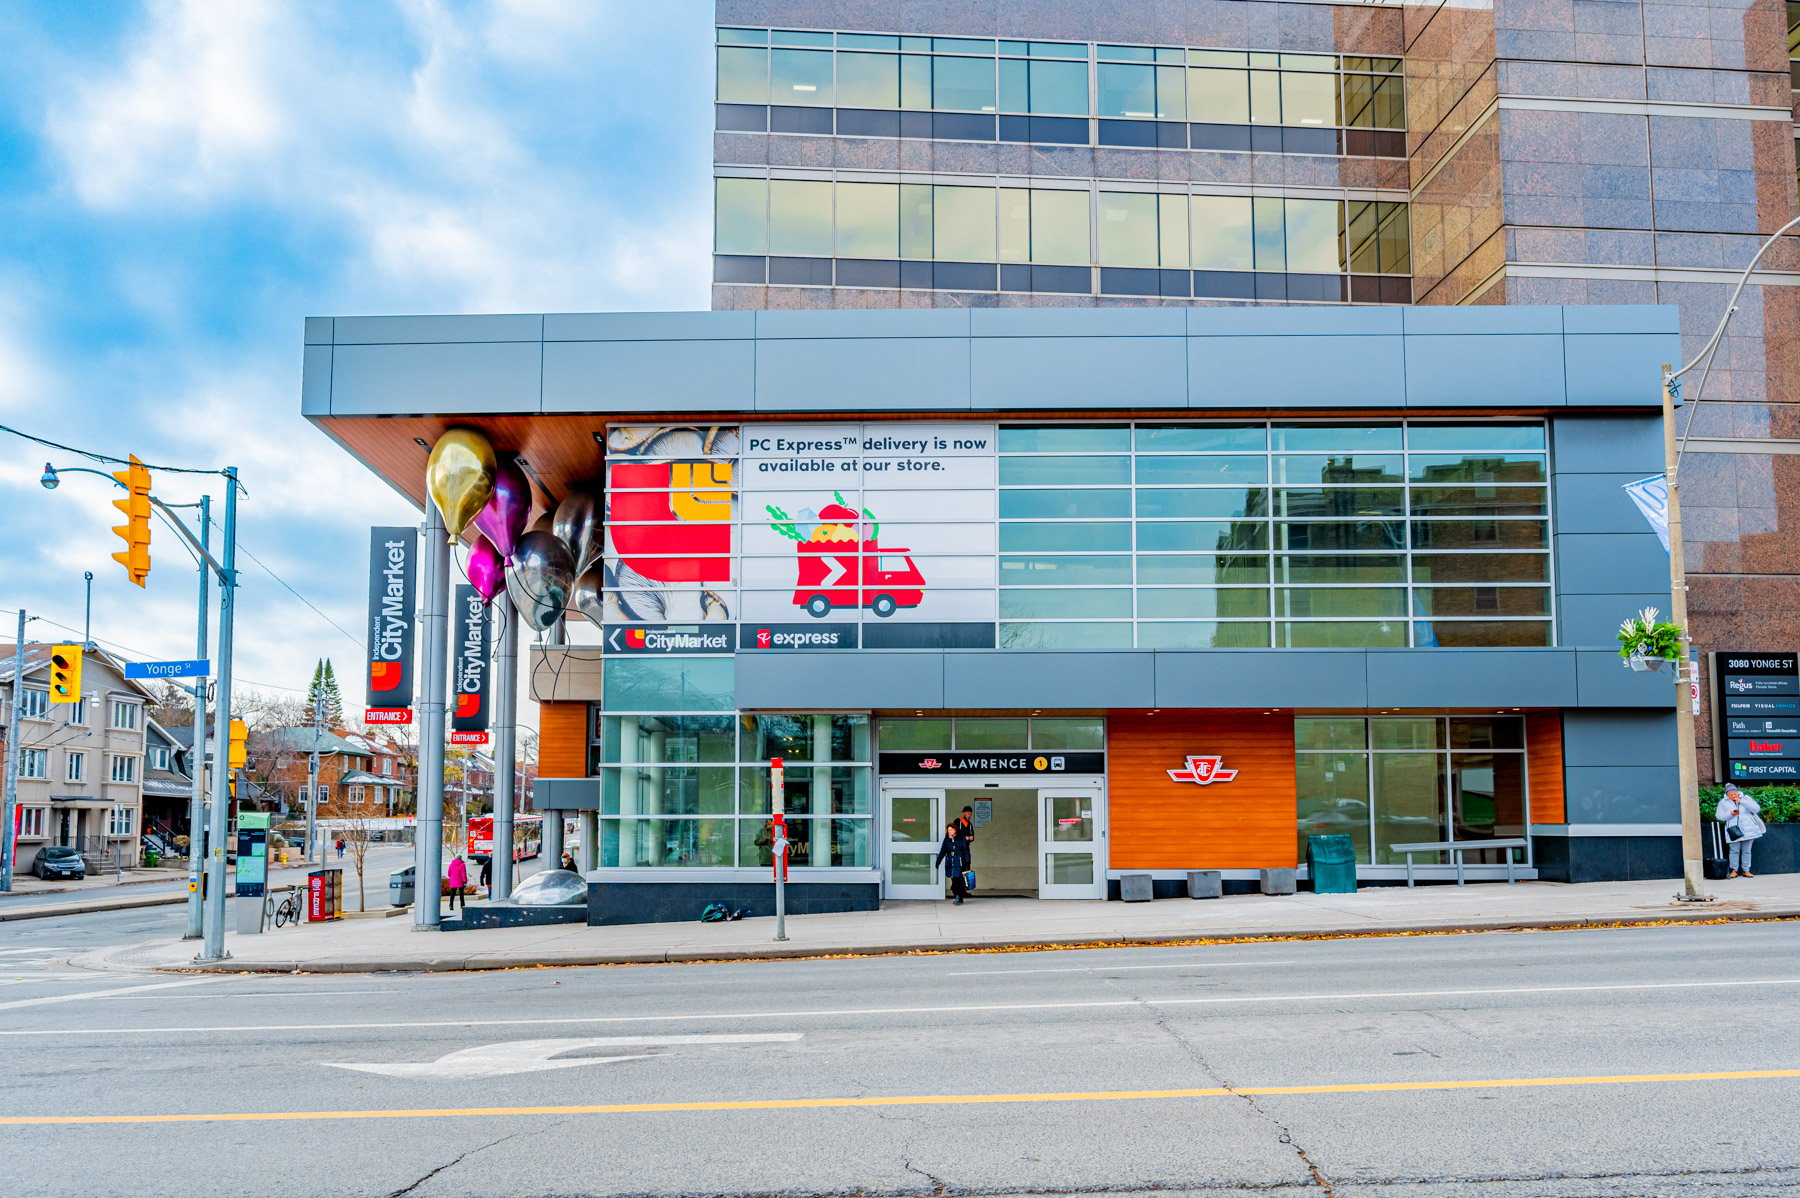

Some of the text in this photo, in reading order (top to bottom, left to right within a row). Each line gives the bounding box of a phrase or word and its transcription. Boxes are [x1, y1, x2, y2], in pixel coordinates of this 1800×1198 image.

[750, 439, 771, 451] PC
[862, 437, 928, 453] delivery
[934, 436, 947, 450] is
[953, 440, 987, 450] now
[758, 458, 945, 472] available at our store.
[380, 540, 408, 660] CityMarket
[372, 616, 380, 660] Independent
[463, 595, 486, 693] CityMarket
[645, 633, 728, 652] CityMarket
[773, 633, 840, 649] express
[146, 663, 182, 677] Yonge
[1728, 659, 1794, 668] 3080 YONGE ST
[1730, 680, 1753, 691] Regus
[367, 711, 401, 721] ENTRANCE
[1732, 721, 1746, 729] Path
[453, 734, 480, 742] ENTRANCE
[1749, 740, 1783, 752] Baker
[949, 758, 1027, 769] LAWRENCE
[1768, 766, 1797, 774] CAPITAL
